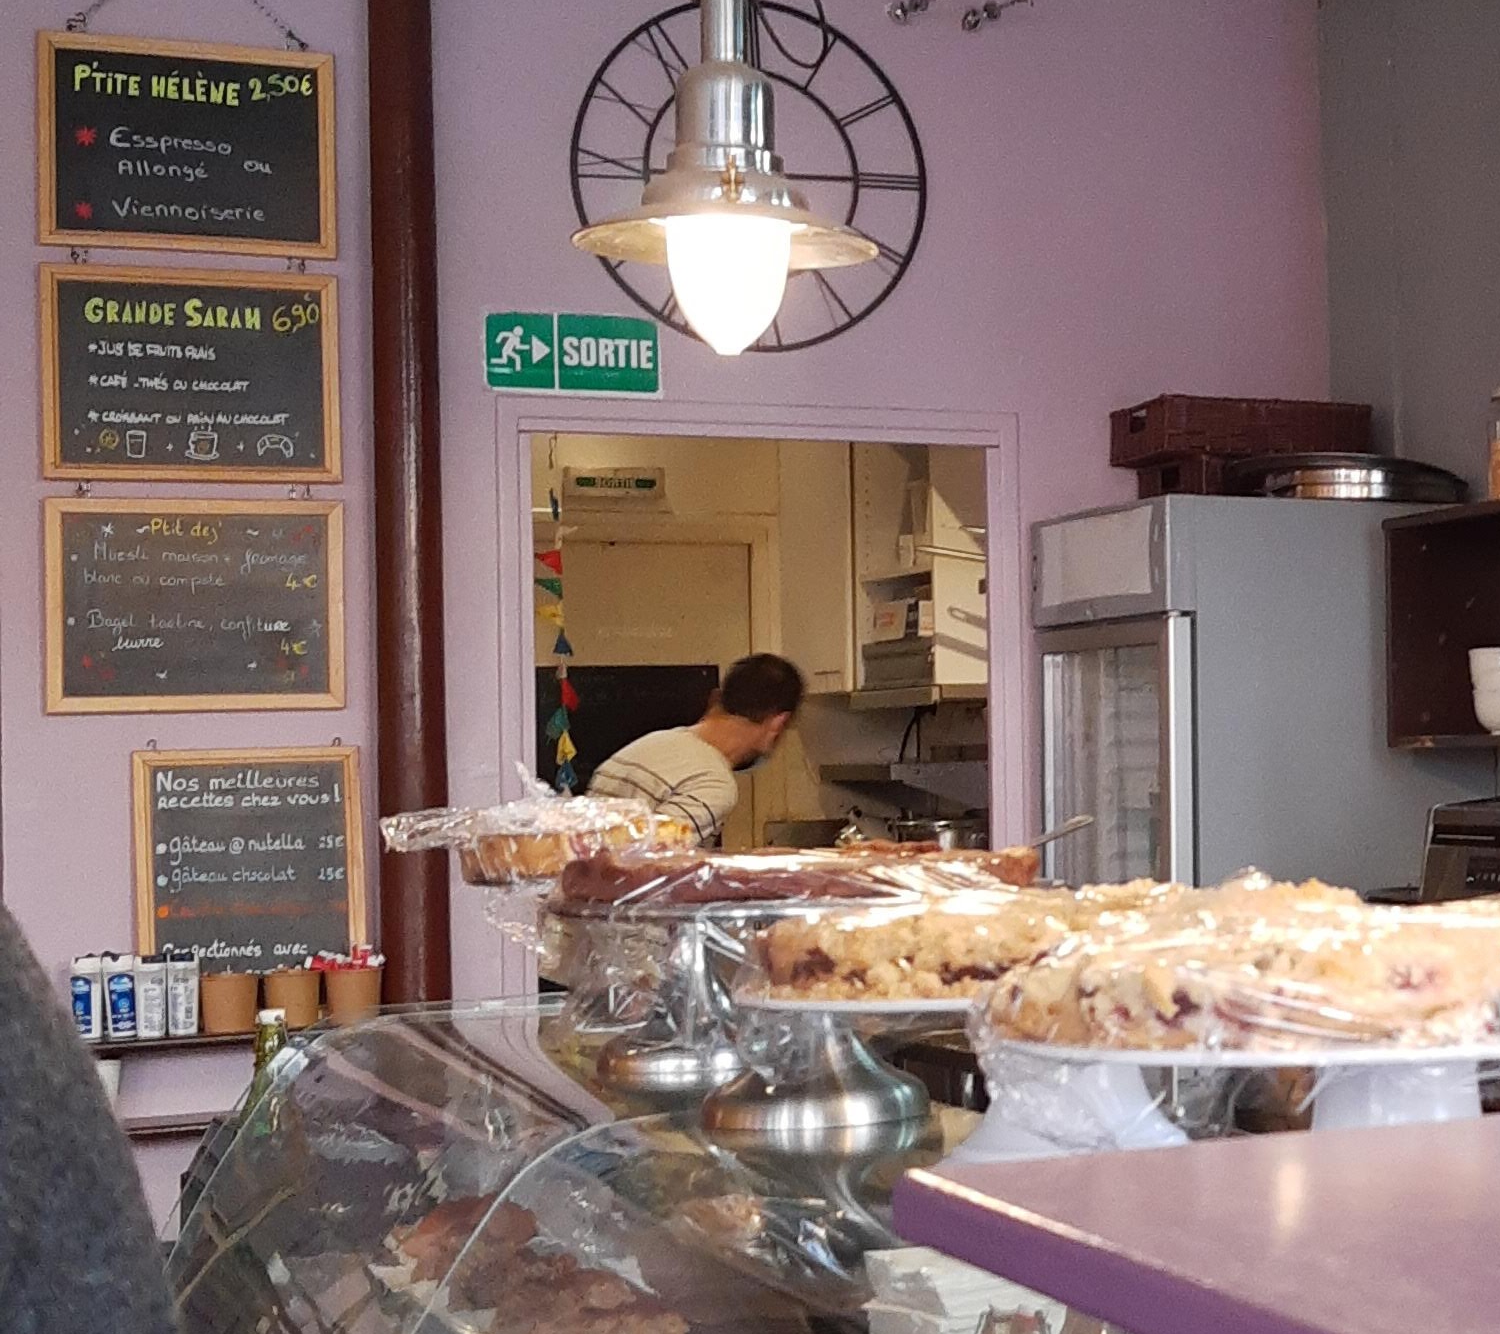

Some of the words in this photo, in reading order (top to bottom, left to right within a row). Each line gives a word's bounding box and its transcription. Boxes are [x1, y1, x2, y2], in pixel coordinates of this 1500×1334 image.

[152, 71, 239, 106] HÉLÈNE
[118, 159, 208, 182] Allongé
[244, 161, 272, 175] ou
[112, 199, 265, 222] Viennoiserie
[85, 297, 176, 326] GRANDE
[184, 299, 261, 330] SARAH
[98, 341, 123, 356] JUS
[128, 342, 144, 356] DE
[563, 337, 653, 369] SORTIE
[94, 541, 148, 562] Muesli
[241, 550, 308, 574] fromage
[84, 568, 121, 584] blanc
[160, 575, 225, 594] compote
[285, 574, 317, 589] 4€
[87, 609, 133, 634] Bagel
[220, 618, 291, 641] confiture
[112, 630, 164, 651] beurre
[157, 771, 199, 792] Nos
[209, 771, 319, 790] meilleures
[241, 793, 281, 807] chez
[248, 833, 305, 851] nutella
[232, 866, 296, 882] chocolat
[274, 944, 308, 956] avec
